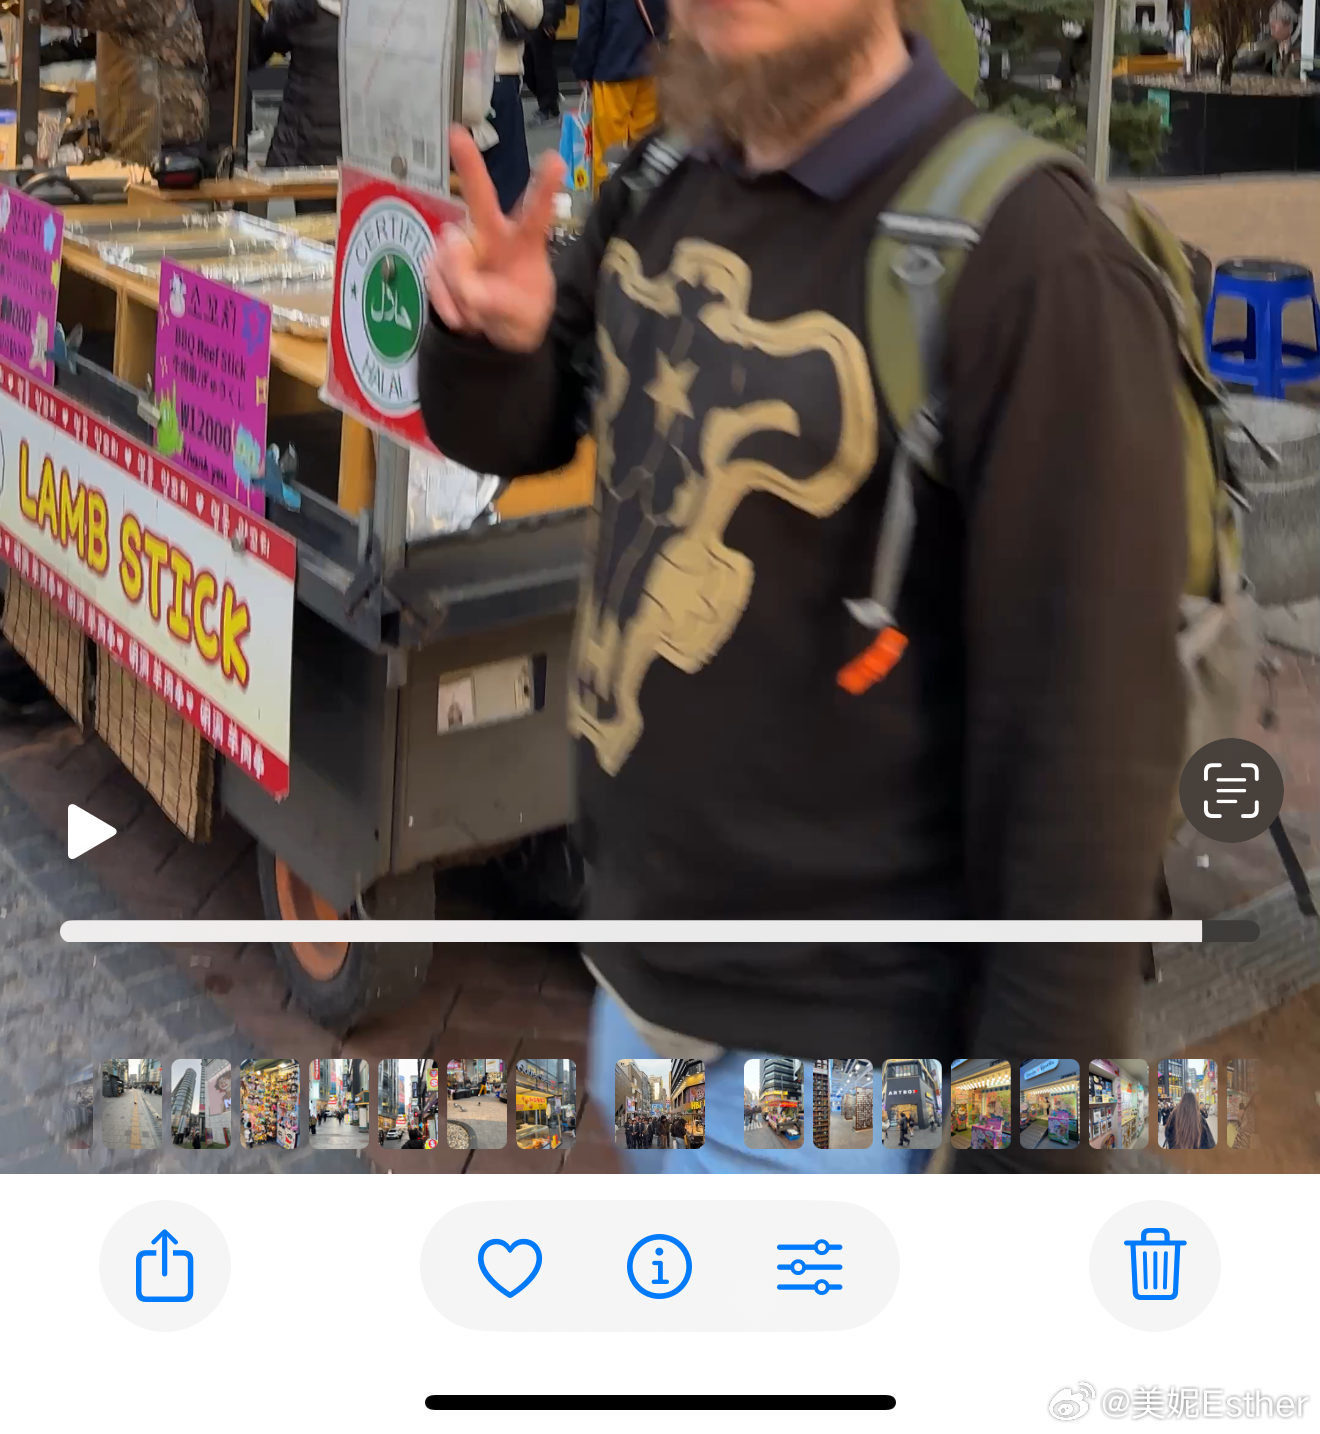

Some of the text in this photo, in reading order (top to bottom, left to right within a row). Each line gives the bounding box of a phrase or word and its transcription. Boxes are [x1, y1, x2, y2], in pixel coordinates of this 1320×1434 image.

[355, 215, 433, 278] CERTIFIE
[188, 283, 237, 338] 소꼬치
[175, 324, 246, 382] BBQ Beef Stick
[19, 438, 250, 690] LAMB STICK
